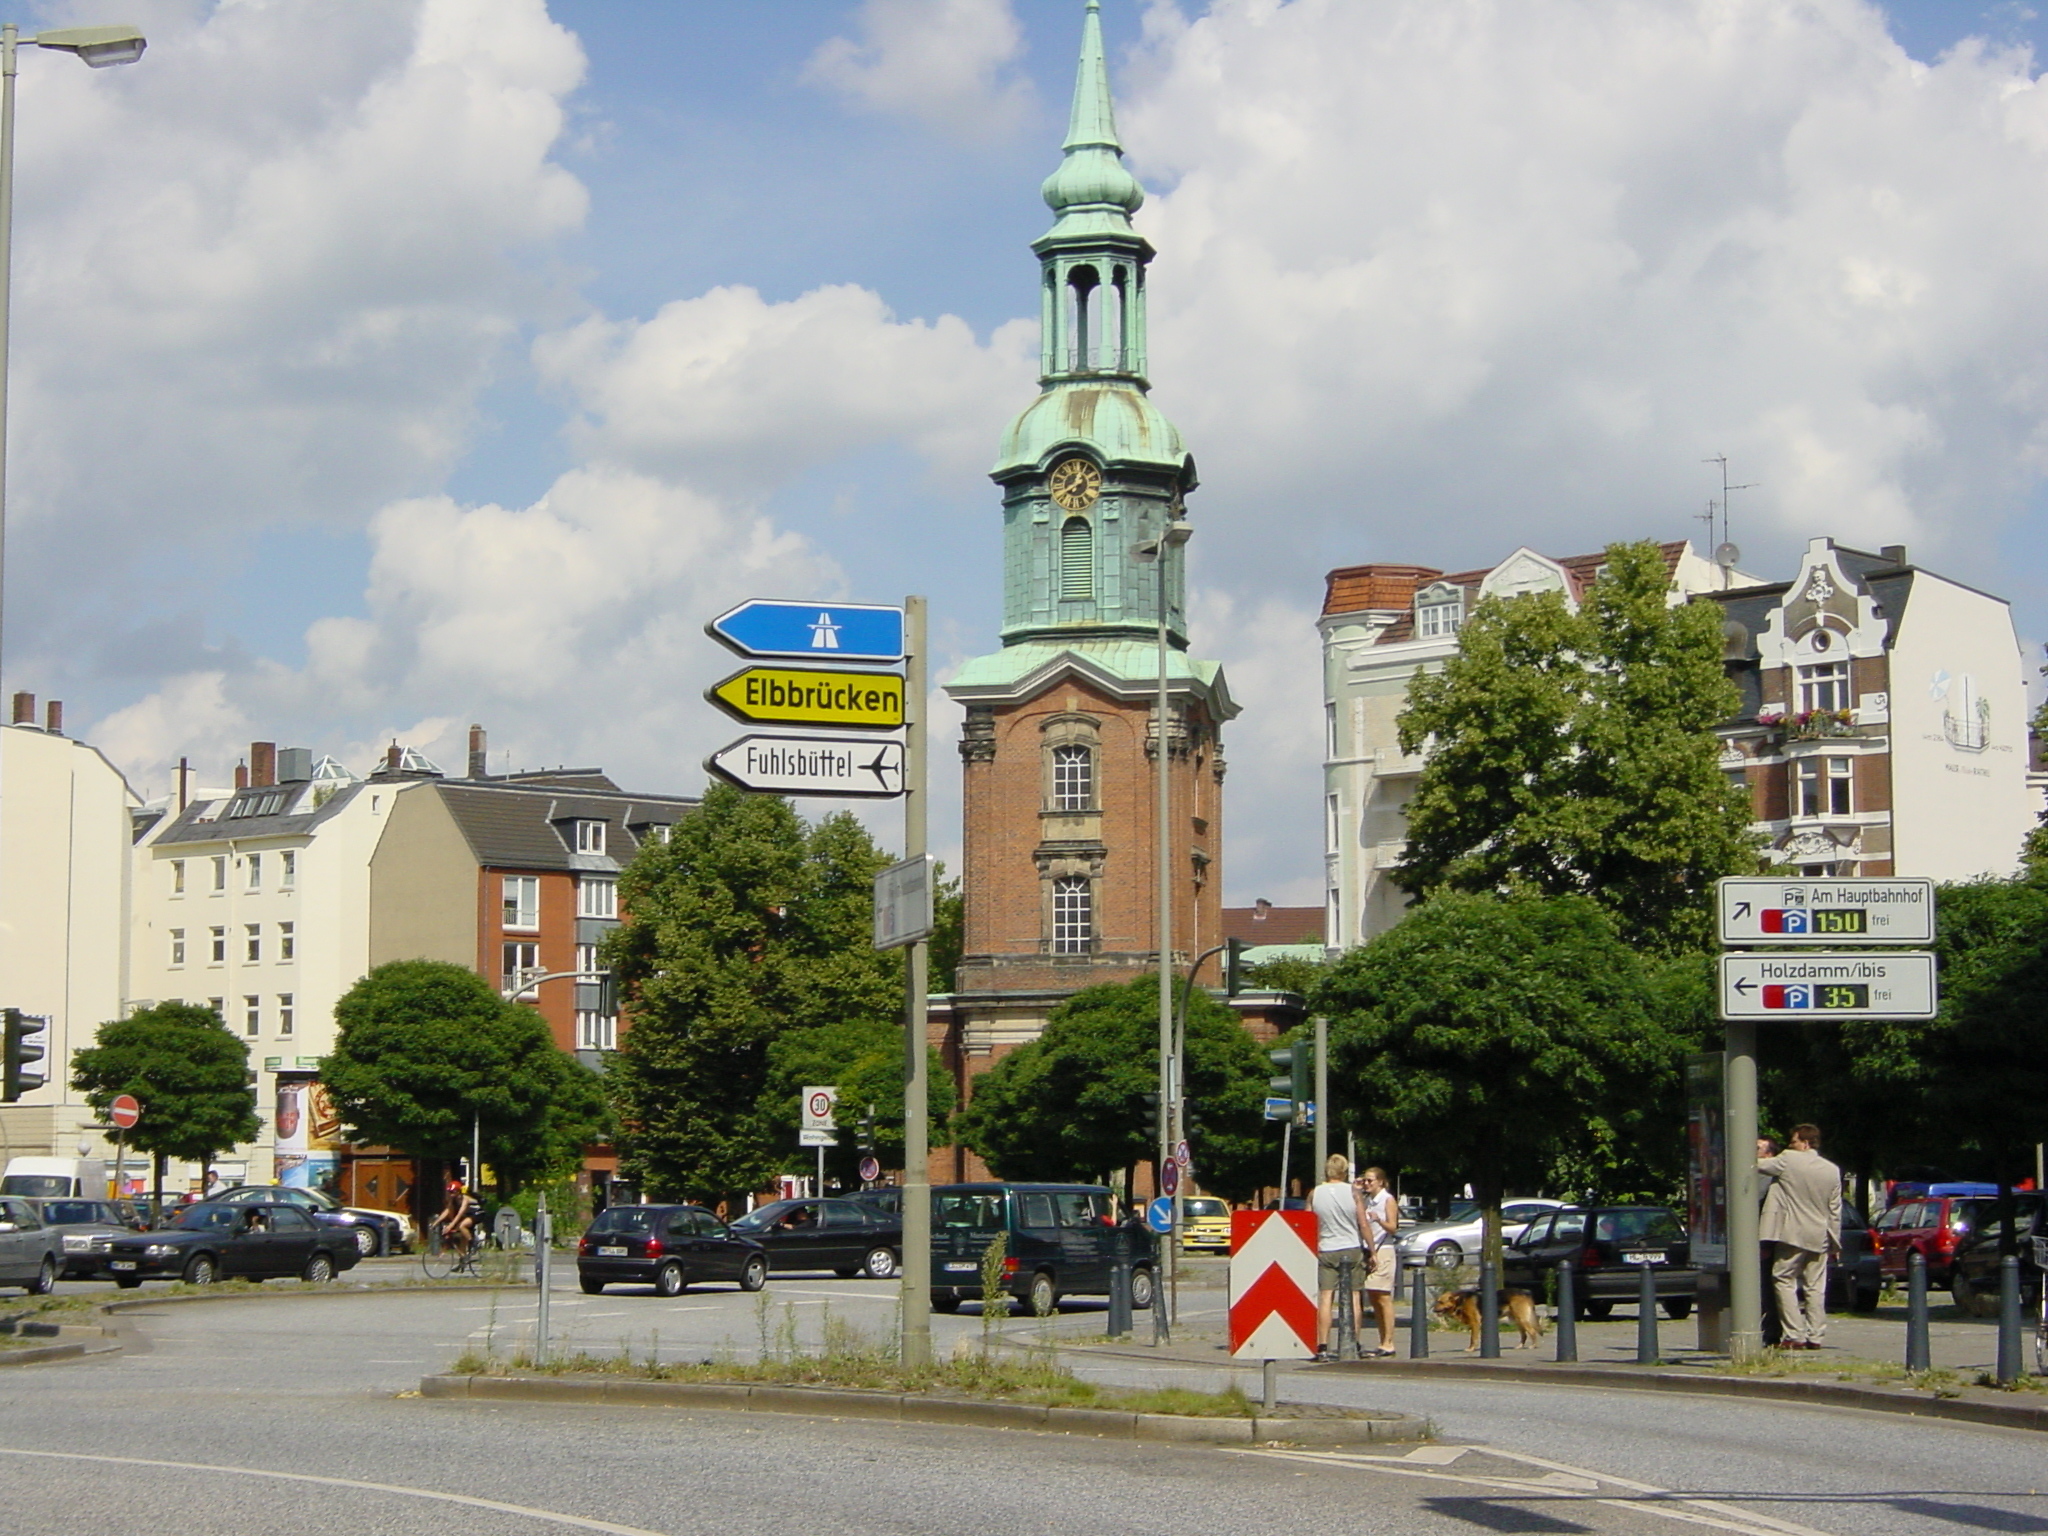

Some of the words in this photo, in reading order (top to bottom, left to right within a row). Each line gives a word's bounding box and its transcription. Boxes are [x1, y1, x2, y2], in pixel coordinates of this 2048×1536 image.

[746, 677, 899, 712] Elbbrücken
[747, 746, 852, 777] Fuhlsbüttel
[1811, 887, 1832, 903] Am
[1837, 887, 1923, 907] Hauptbahnhof
[1788, 917, 1800, 932] P
[1816, 912, 1859, 932] 150
[1872, 914, 1890, 926] frei
[1761, 962, 1887, 978] Holzdamm/ibis
[1790, 992, 1802, 1008] P
[1824, 987, 1855, 1008] 35
[1874, 989, 1892, 1001] frei
[814, 1098, 825, 1111] 30
